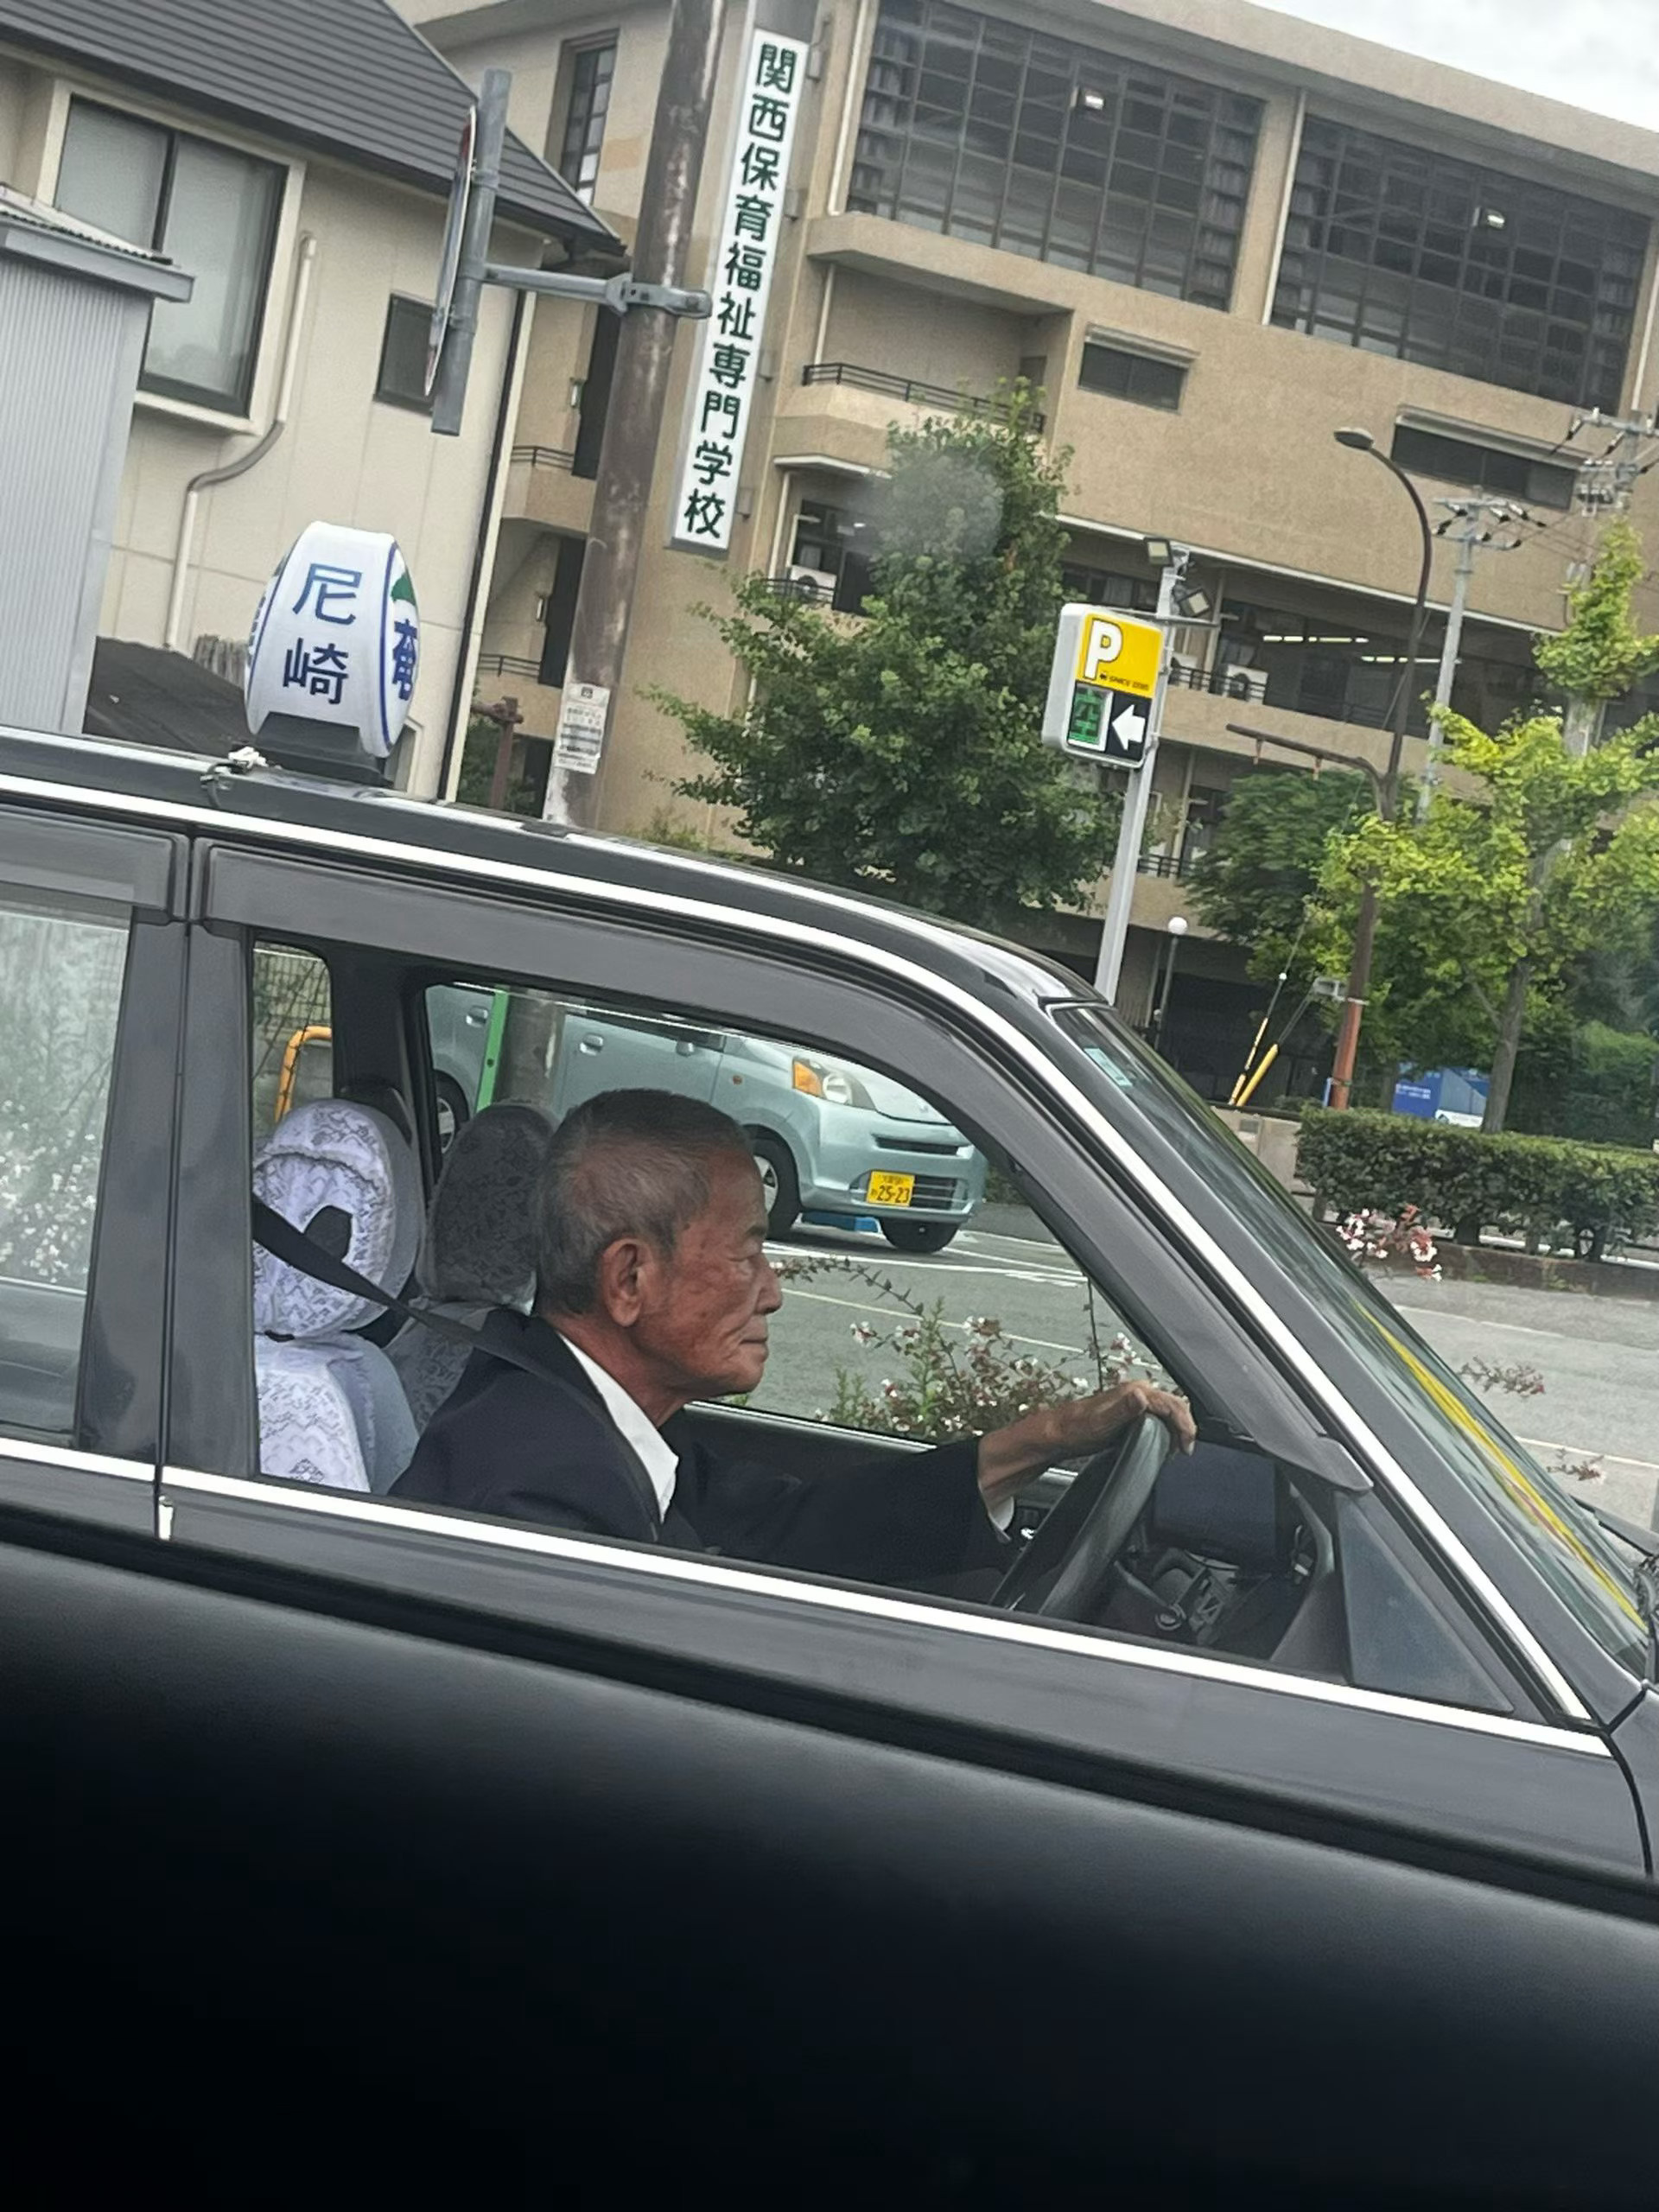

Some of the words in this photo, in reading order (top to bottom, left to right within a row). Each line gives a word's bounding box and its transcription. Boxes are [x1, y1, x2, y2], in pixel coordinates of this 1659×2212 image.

[683, 43, 798, 539] 関西保育福祉専門学校
[283, 563, 363, 705] 尼崎
[1084, 618, 1122, 681] P
